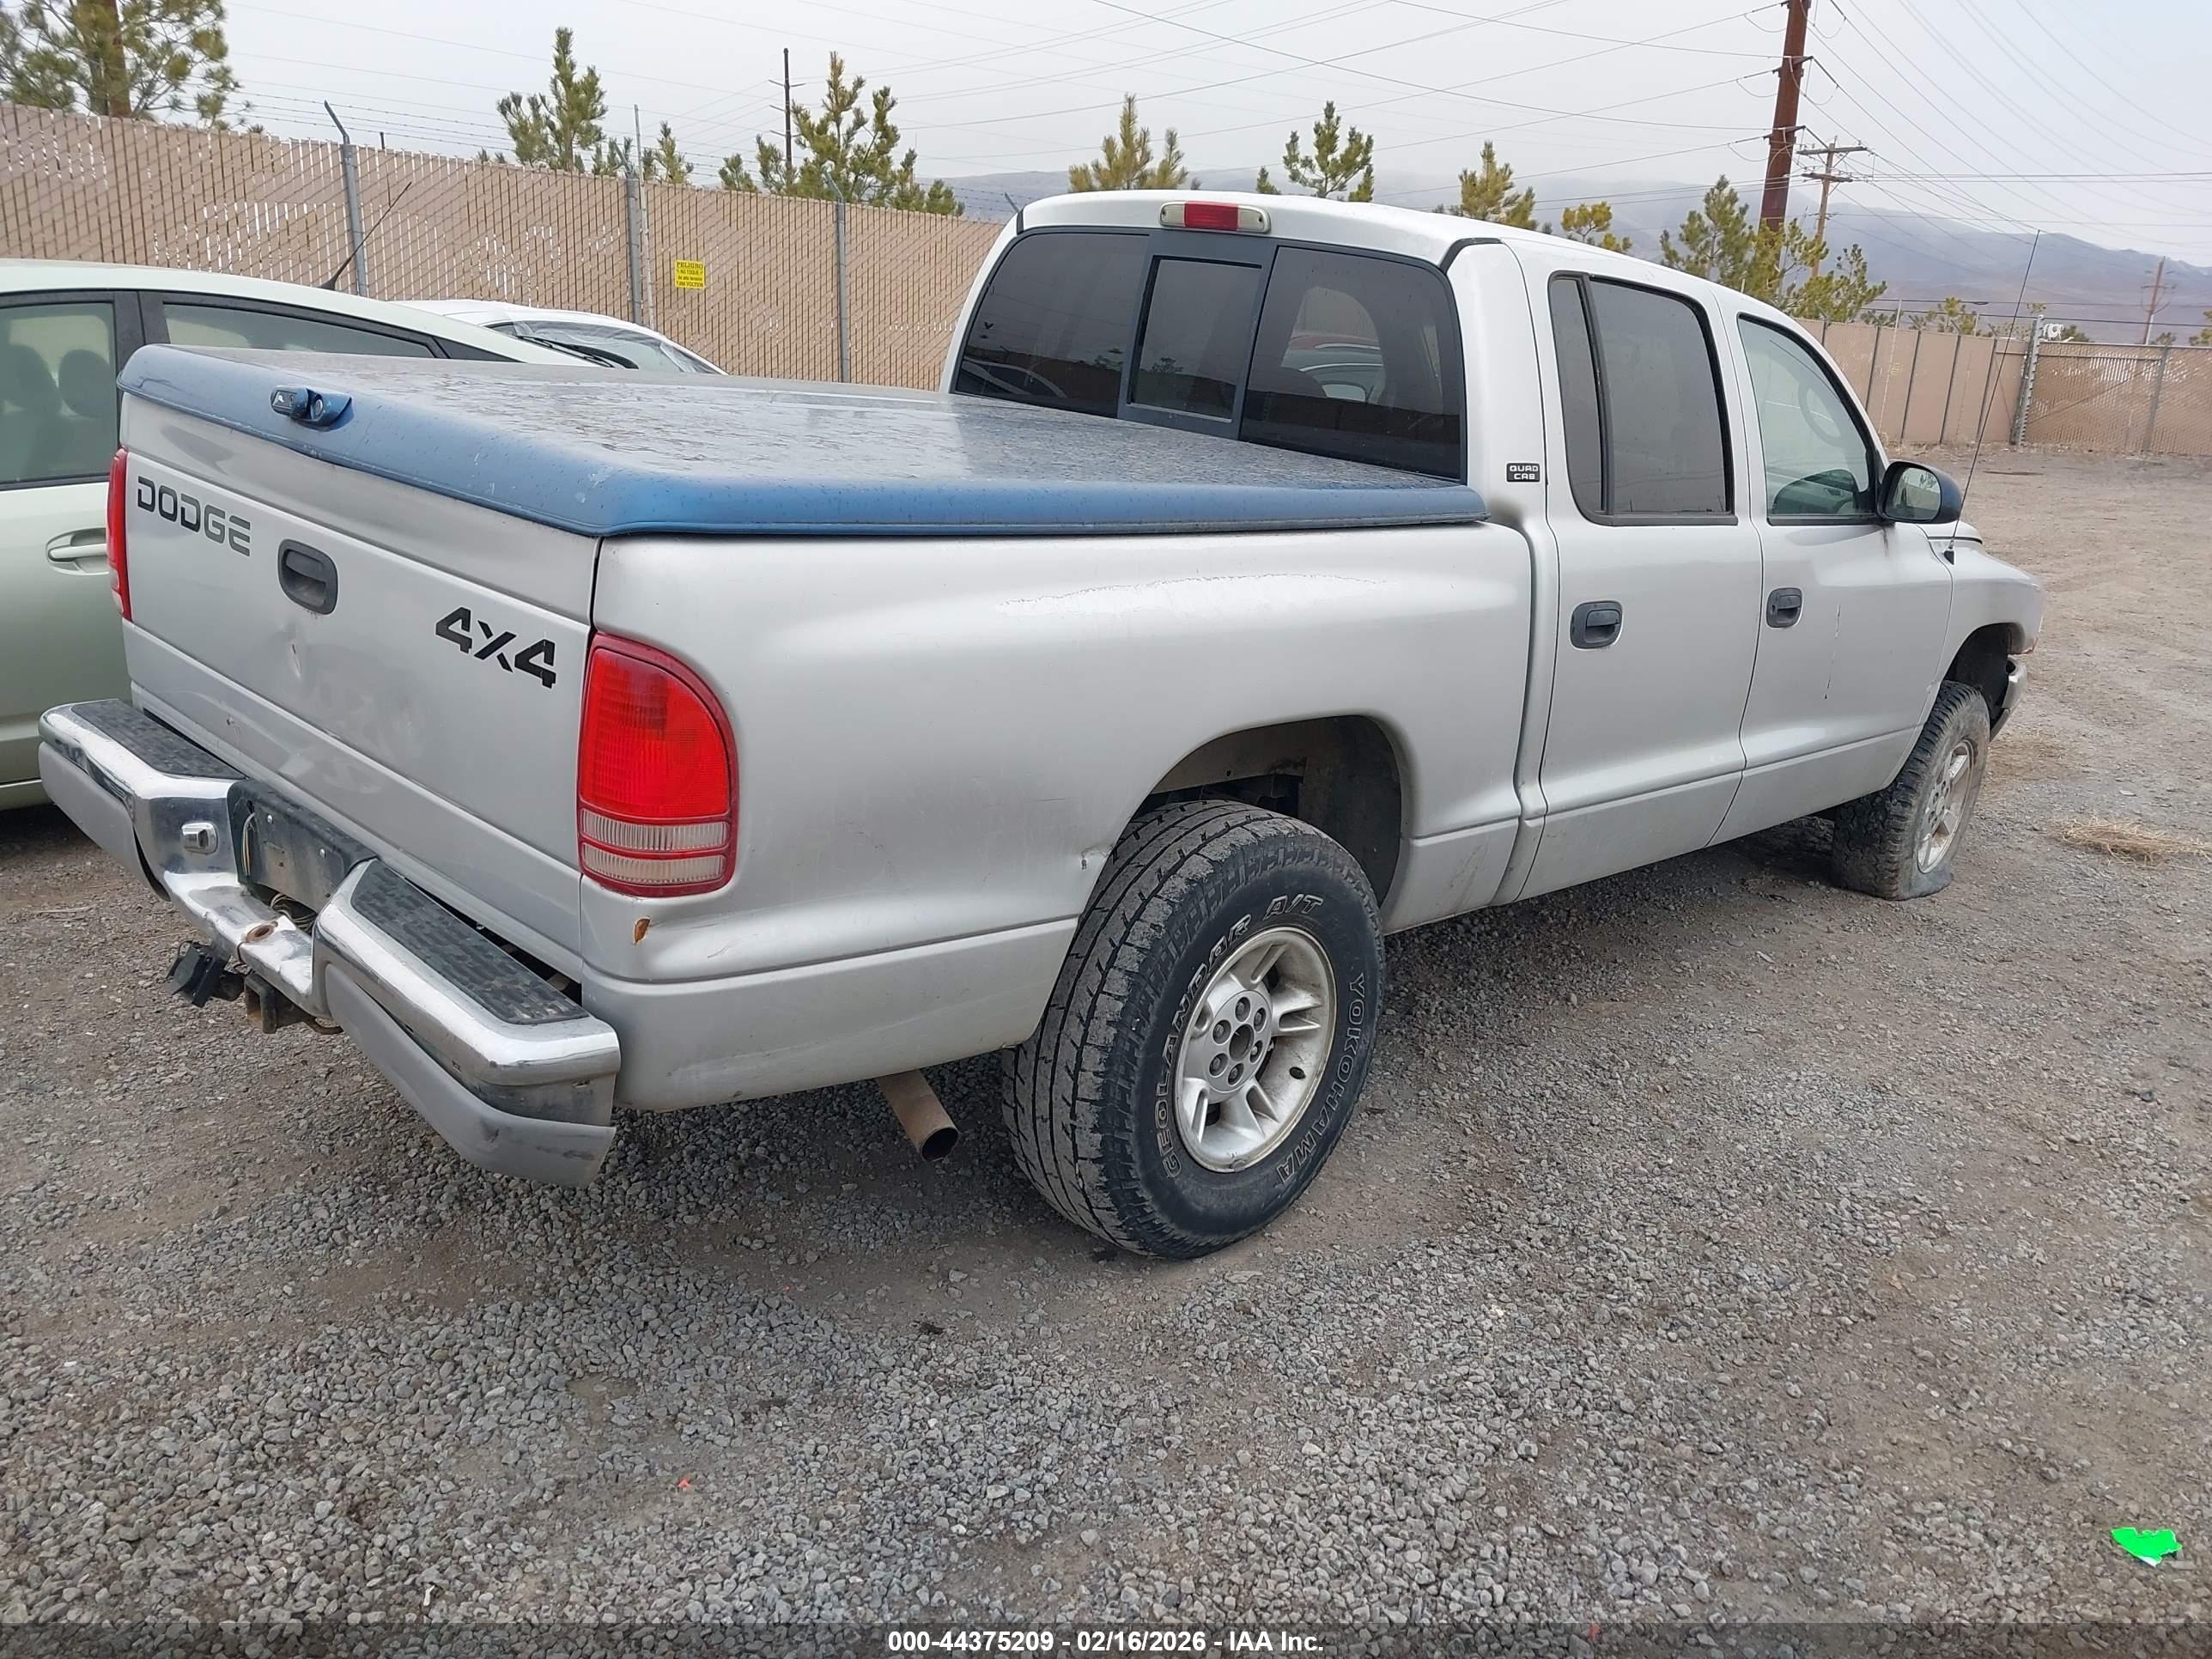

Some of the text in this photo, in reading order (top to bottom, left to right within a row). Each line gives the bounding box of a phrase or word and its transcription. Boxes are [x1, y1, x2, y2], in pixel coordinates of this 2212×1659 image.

[137, 475, 251, 557] DODGE
[1155, 894, 1324, 1179] GEOLANDAR A/T
[1276, 972, 1365, 1184] YOKOHAMA
